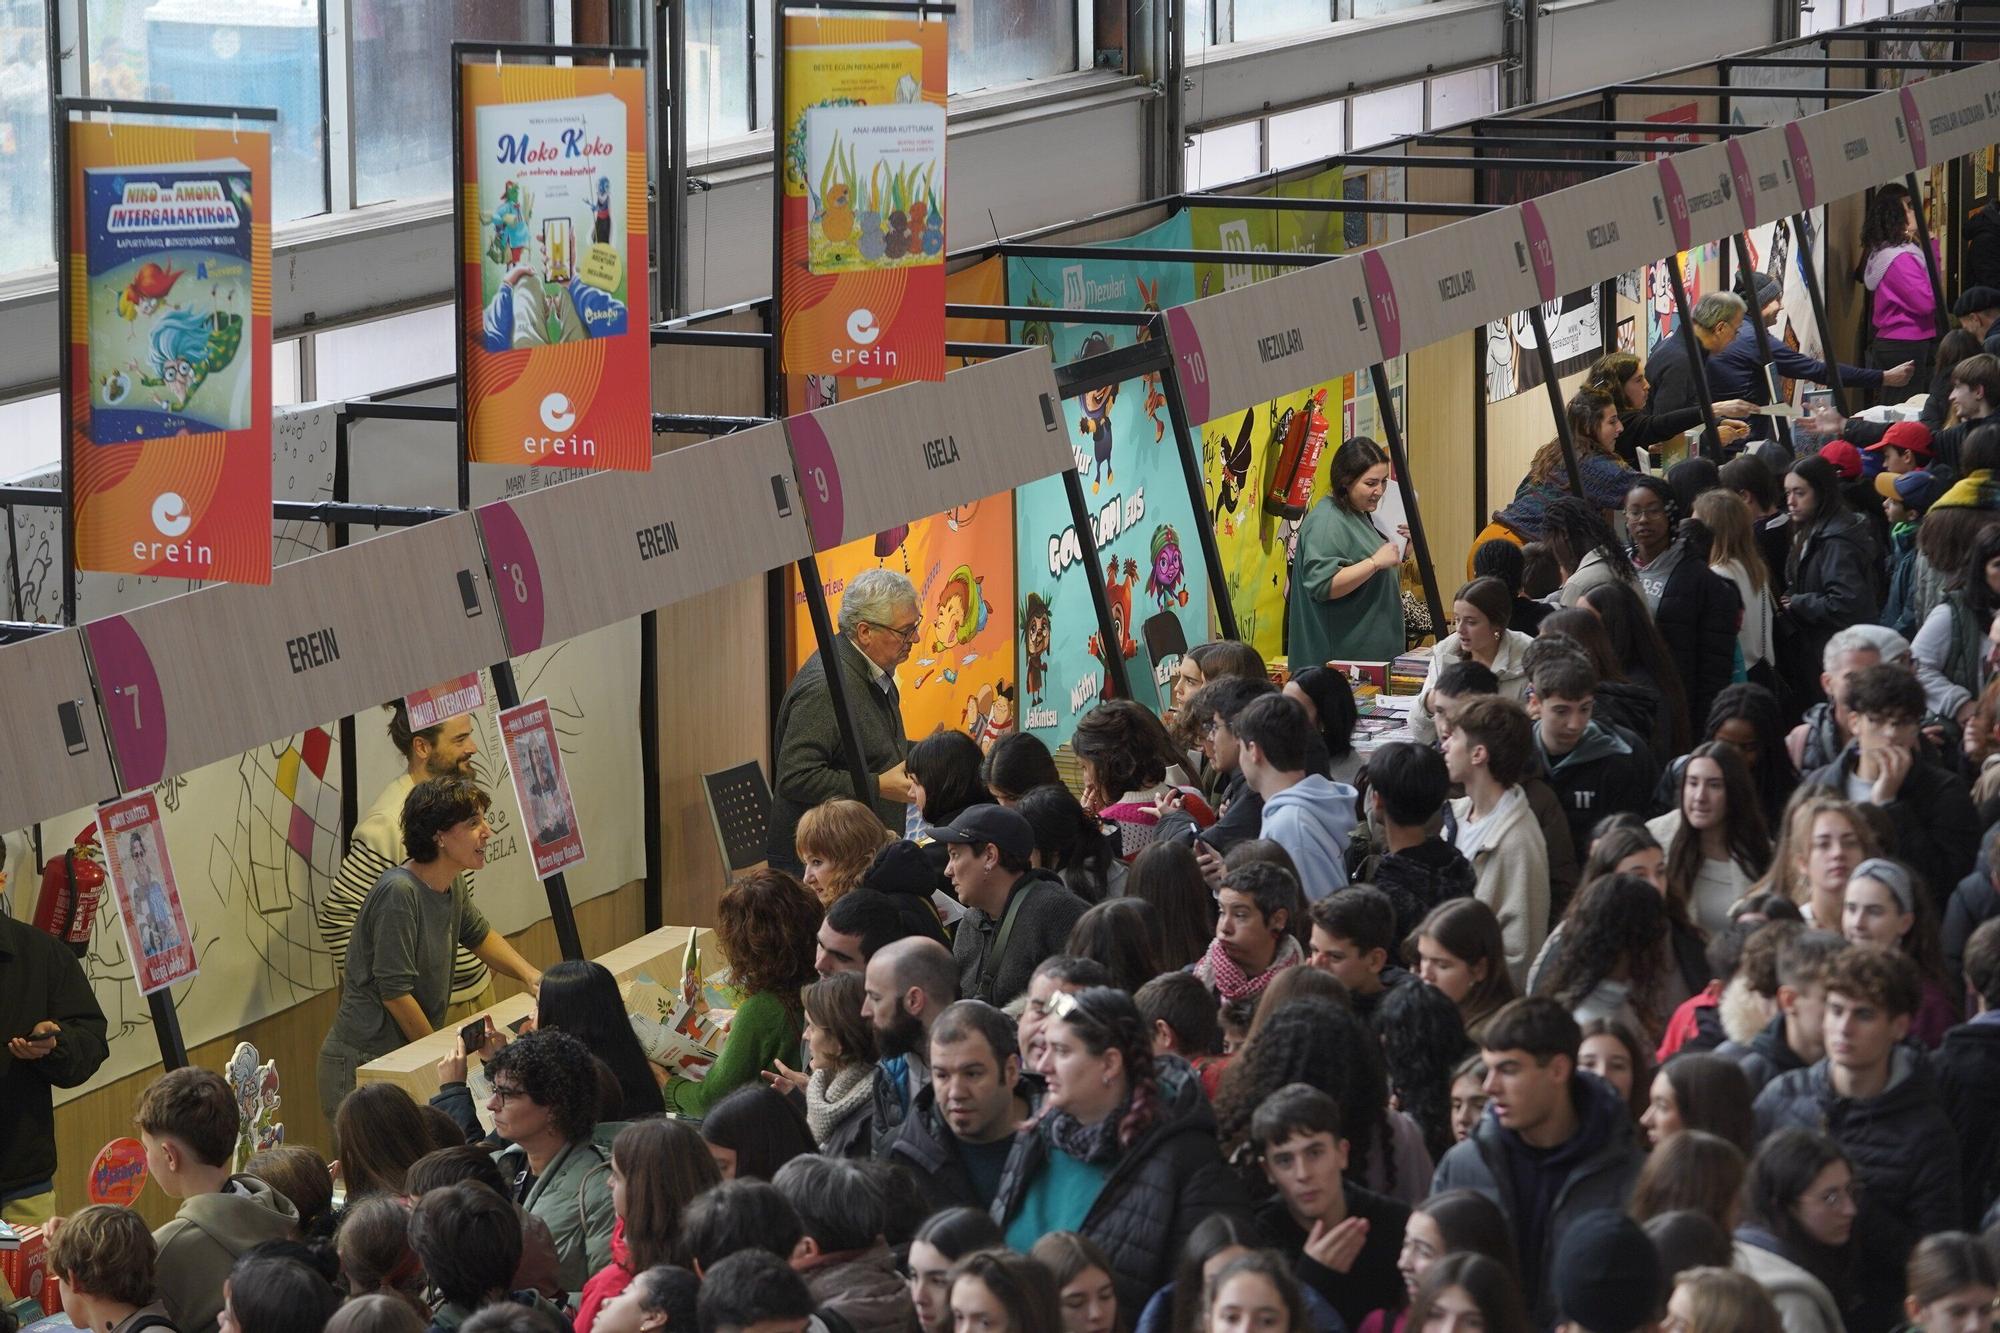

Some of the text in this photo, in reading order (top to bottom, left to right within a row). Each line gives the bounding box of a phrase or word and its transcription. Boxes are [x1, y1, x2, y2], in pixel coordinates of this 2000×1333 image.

[496, 128, 613, 165] Moko Koko
[127, 185, 158, 203] NIKO
[175, 184, 221, 201] AMONA
[111, 206, 235, 228] INTERGALAKTIKOA
[1586, 220, 1620, 250] MEZULARI
[1438, 268, 1478, 302] MEZULARI
[1381, 294, 1398, 323] 11
[831, 346, 897, 366] erein
[1257, 327, 1304, 363] MEZULARI
[1186, 352, 1205, 386] 10
[524, 434, 595, 456] erein
[922, 435, 960, 470] IGELA
[505, 473, 527, 493] MARY
[814, 467, 830, 503] 9
[133, 540, 212, 564] erein
[636, 521, 680, 561] EREIN
[510, 563, 528, 603] 8
[286, 627, 341, 674] EREIN
[124, 684, 142, 729] 7
[411, 700, 436, 727] HAUR
[432, 685, 482, 720] LITERATURA
[1025, 706, 1058, 730] Jakintsu
